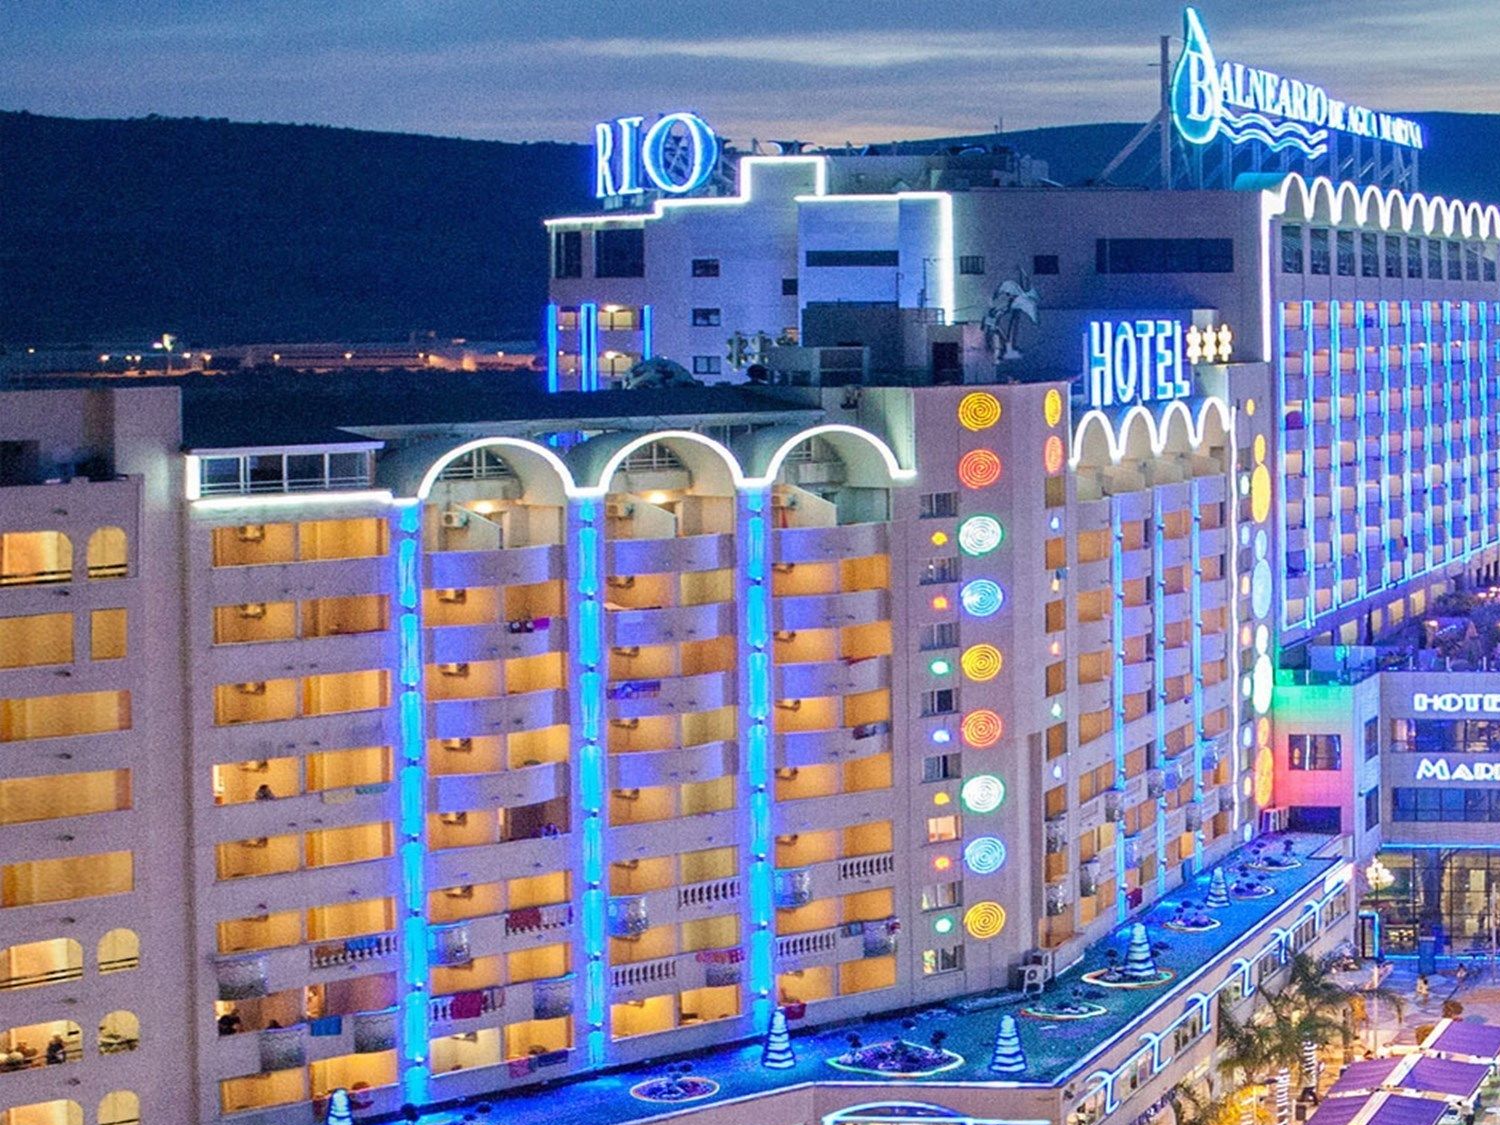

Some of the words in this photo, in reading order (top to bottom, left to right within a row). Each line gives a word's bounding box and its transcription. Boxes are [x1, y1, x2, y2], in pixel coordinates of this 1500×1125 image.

[1186, 50, 1328, 127] BALNEARIO
[1327, 98, 1346, 130] DE
[596, 112, 718, 198] RIO
[1090, 320, 1190, 407] HOTEL
